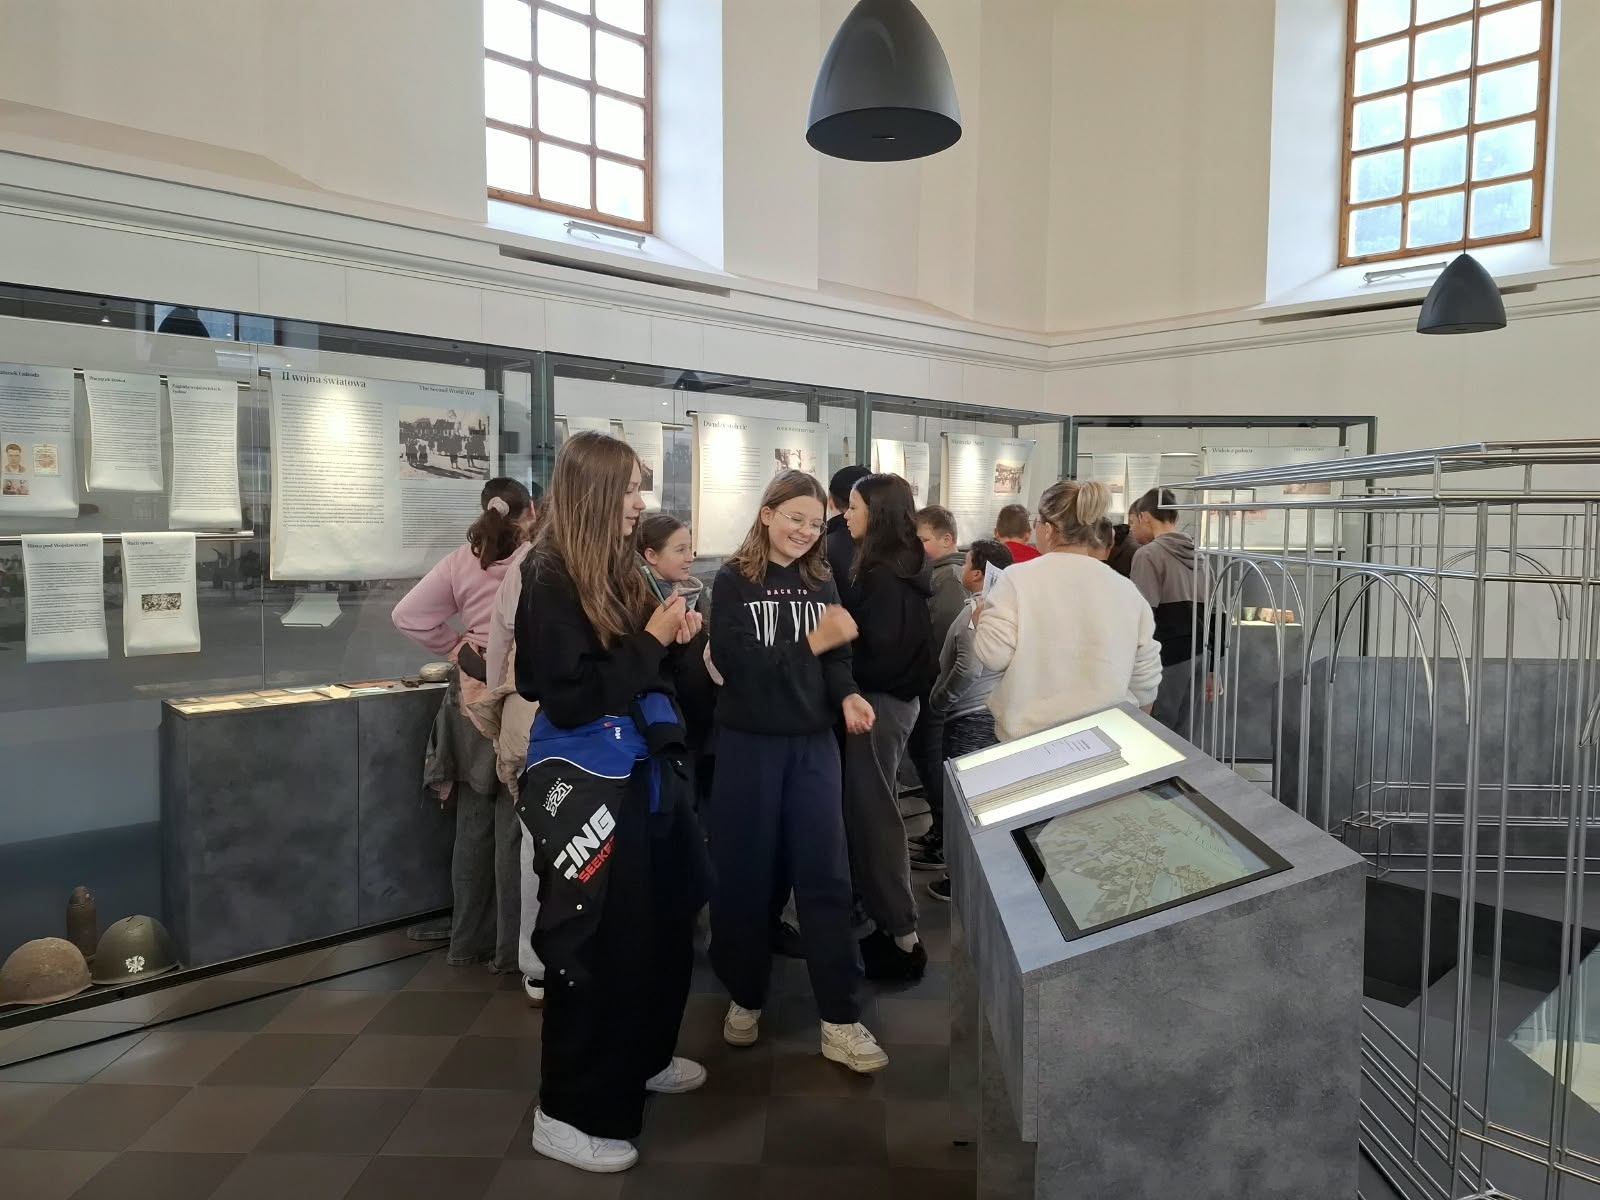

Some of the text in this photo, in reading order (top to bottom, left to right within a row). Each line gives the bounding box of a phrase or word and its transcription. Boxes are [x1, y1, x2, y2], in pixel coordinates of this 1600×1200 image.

[282, 371, 367, 388] II wojna światowa
[578, 836, 615, 883] SEEKE
